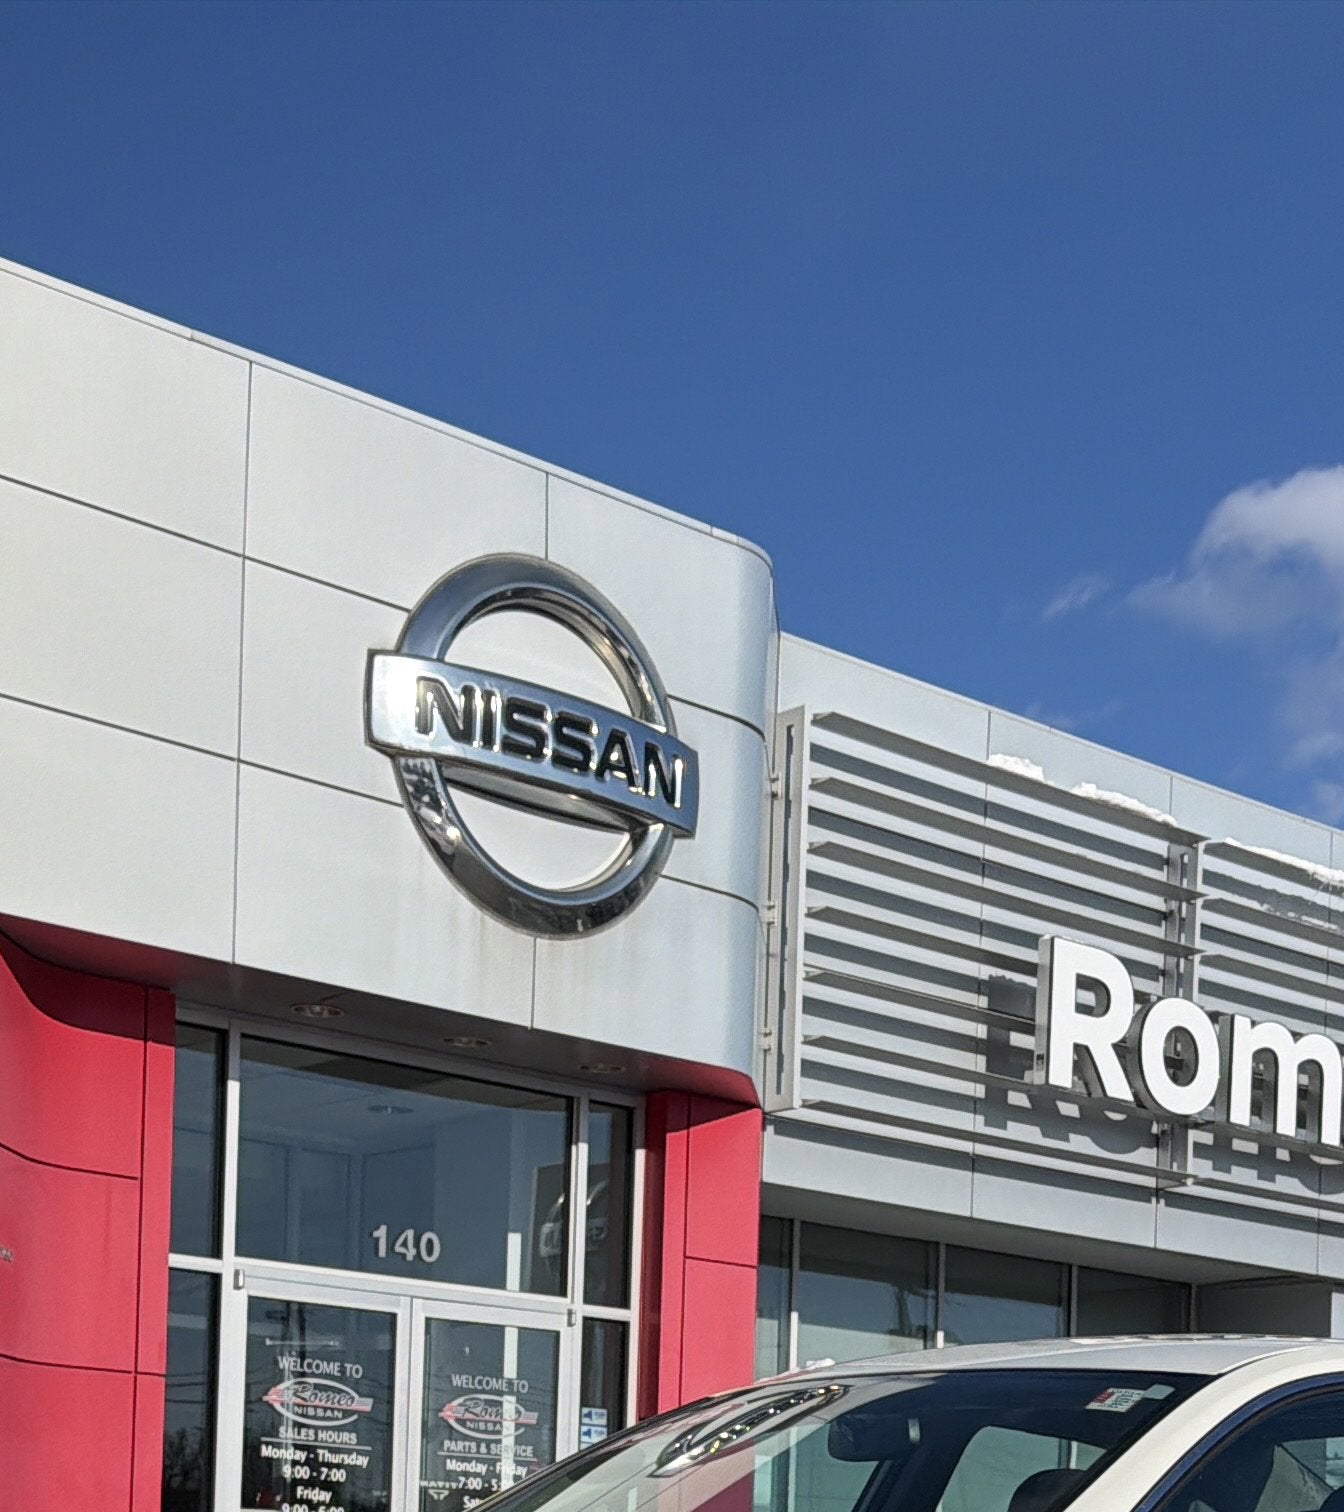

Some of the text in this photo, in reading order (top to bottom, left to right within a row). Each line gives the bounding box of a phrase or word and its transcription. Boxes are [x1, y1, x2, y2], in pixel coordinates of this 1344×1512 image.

[415, 676, 687, 808] NISSAN
[373, 1225, 440, 1263] 140
[278, 1356, 363, 1378] WELCOME TO
[451, 1374, 528, 1394] WELCOME TO
[294, 1406, 343, 1419] NISSAN
[459, 1399, 522, 1420] Romo
[278, 1427, 357, 1445] SALES HOURS
[443, 1440, 477, 1453] PARTS
[479, 1442, 488, 1453] &
[260, 1444, 308, 1463] Monday
[317, 1449, 370, 1468] Thursday
[282, 1464, 310, 1479] 9:00
[319, 1467, 346, 1482] 7:00
[446, 1459, 488, 1475] Monday
[457, 1476, 482, 1490] 7:00
[296, 1486, 332, 1503] Friday
